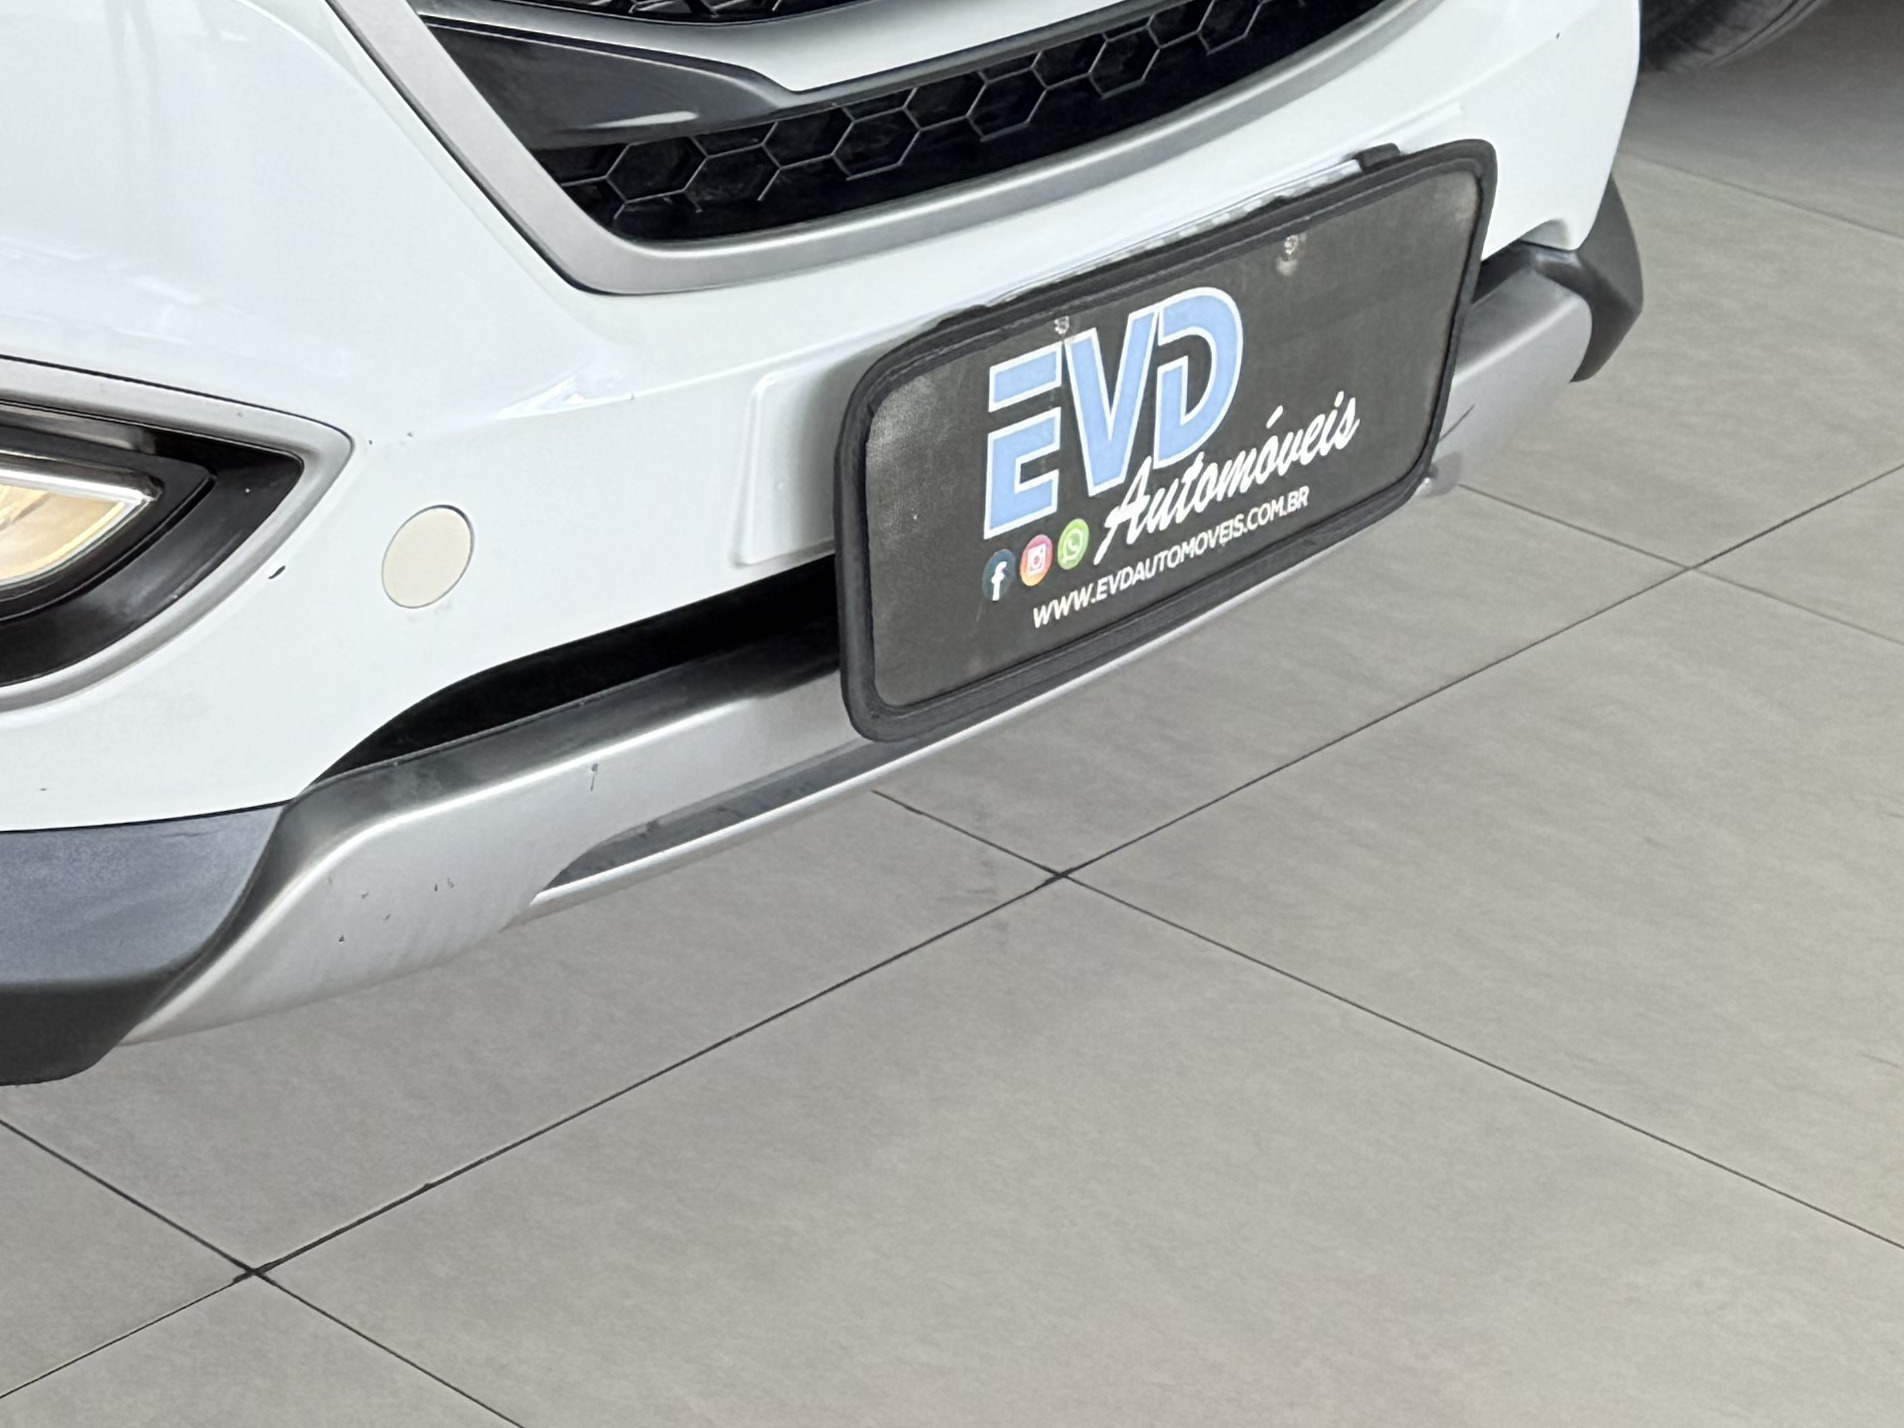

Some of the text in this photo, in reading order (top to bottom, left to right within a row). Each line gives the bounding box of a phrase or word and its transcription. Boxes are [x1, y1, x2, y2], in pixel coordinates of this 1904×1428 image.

[983, 286, 1245, 540] EVD
[1093, 390, 1361, 566] Automóveis
[1032, 485, 1311, 629] WWW.EVDAUTOMOVEIS.COM.BR
